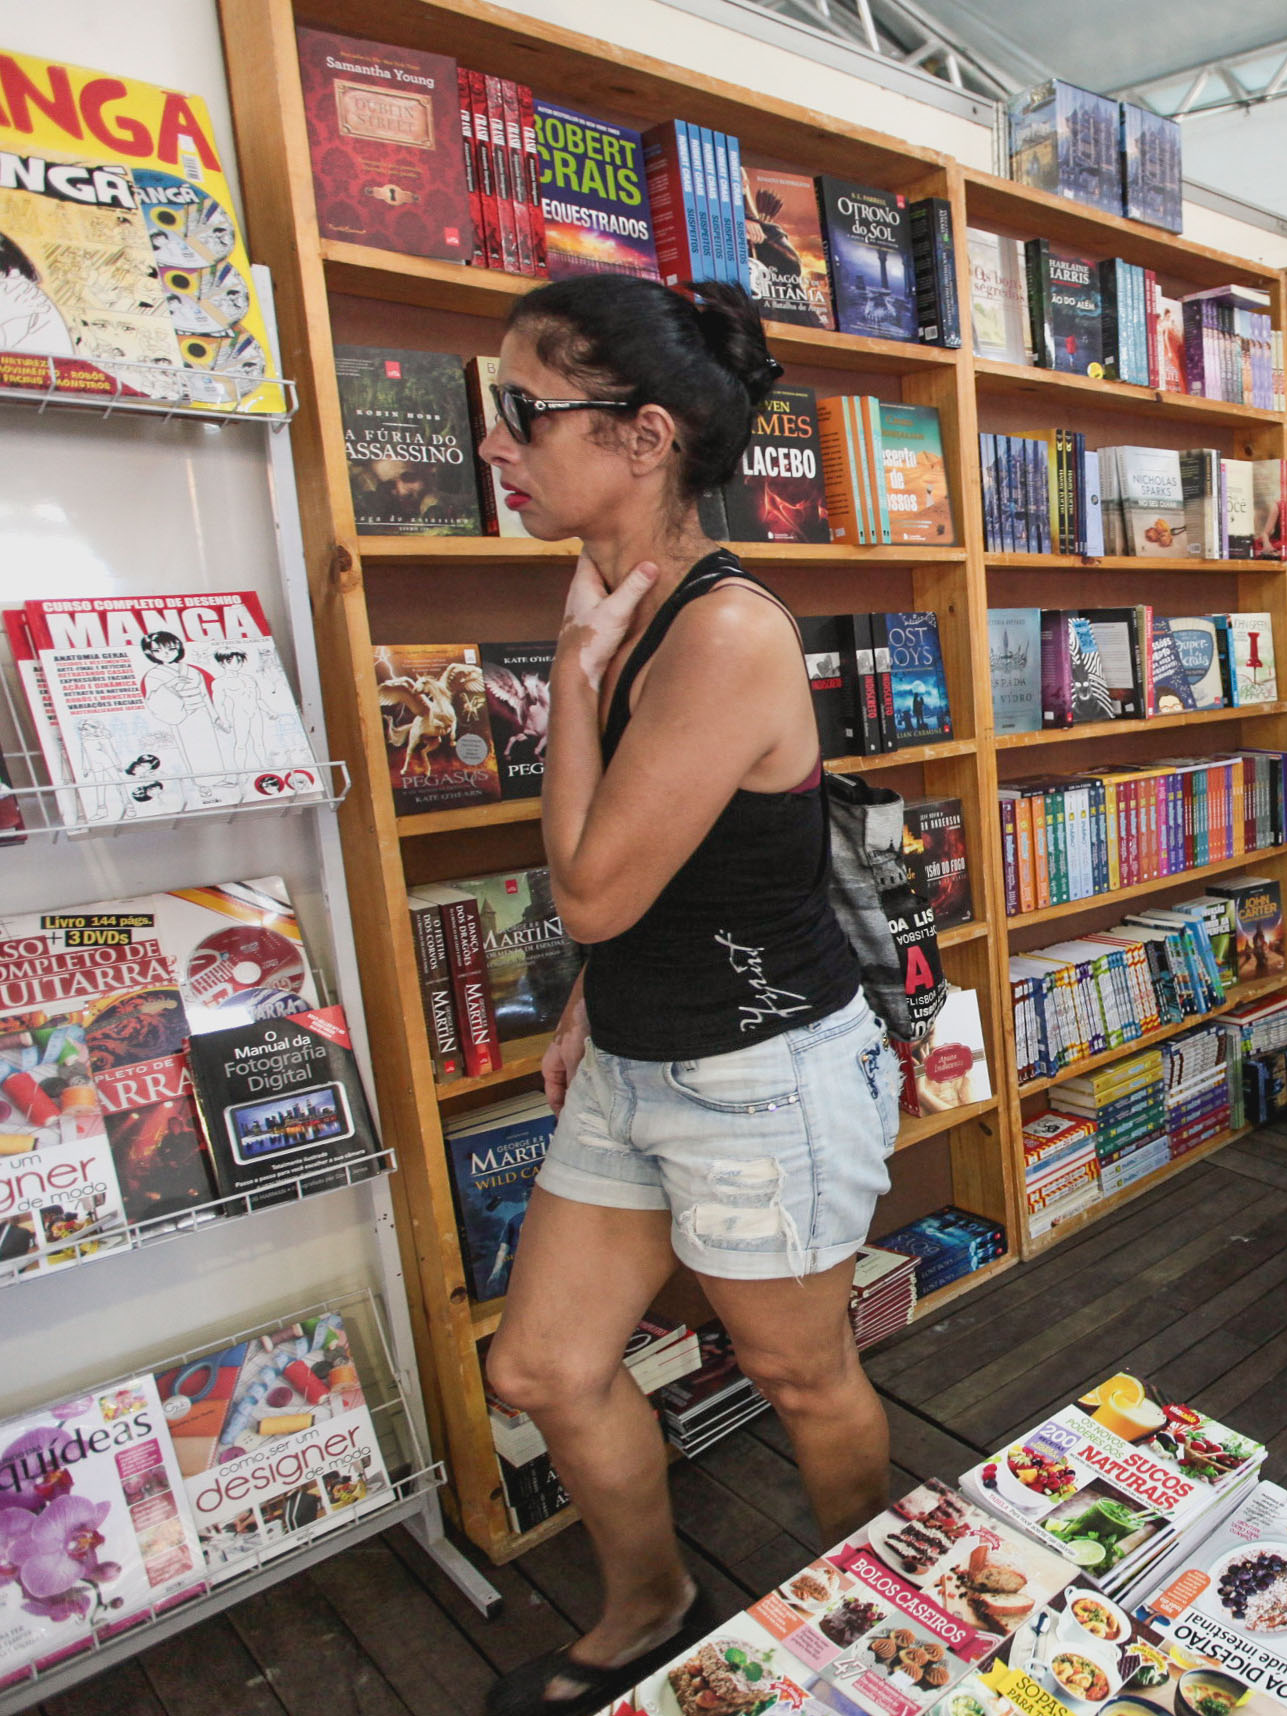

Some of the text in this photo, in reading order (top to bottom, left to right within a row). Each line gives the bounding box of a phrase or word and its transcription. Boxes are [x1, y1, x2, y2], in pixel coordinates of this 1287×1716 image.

[326, 56, 435, 88] Samantha Young
[0, 53, 221, 172] NGÁ
[541, 197, 649, 241] EQUESTRADOS
[687, 208, 698, 254] SUSPEITOS
[699, 211, 711, 257] SUSPEITOS
[852, 219, 896, 244] do SOL
[712, 214, 723, 260] SUSPEITOS
[724, 217, 735, 263] SUSPEITOS
[736, 221, 747, 265] SUSPEITOS
[1049, 259, 1089, 274] HARLAINE
[365, 428, 457, 446] FÚRIA DO
[751, 415, 813, 439] MES
[344, 442, 464, 465] ASSASSINO
[742, 445, 816, 479] LACEBO
[890, 468, 905, 489] de
[1132, 474, 1177, 487] NICHOLAS
[1141, 485, 1172, 497] SPARKS
[42, 595, 242, 612] CURSO COMPLETO DE DESENHO
[503, 655, 556, 664] KATE O'HEA
[402, 769, 489, 790] PEGASUS
[951, 857, 965, 873] FOGO
[1238, 903, 1278, 920] CARTER
[1246, 894, 1270, 910] JOHN
[45, 916, 152, 929] Livro 144 págs.
[68, 931, 129, 945] 3 DVDs
[456, 905, 472, 967] DOS DRAGÕES
[467, 922, 479, 954] DANÇA
[124, 940, 160, 957] DE
[423, 914, 438, 970] DOS CORVOS
[434, 928, 446, 960] FESTIM
[432, 990, 457, 1054] MARTIN
[466, 983, 490, 1045] MARTIN
[234, 1034, 311, 1060] Manual da
[265, 1030, 277, 1042] O
[153, 1059, 174, 1070] DE
[224, 1044, 327, 1079] Fotografia
[247, 1063, 313, 1093] Digital
[10, 1154, 42, 1169] um
[471, 1142, 546, 1175] MARTI
[497, 1139, 529, 1153] GEORGE
[475, 1170, 517, 1191] WILD
[17, 1181, 107, 1213] de moda
[1040, 1423, 1078, 1448] 200
[1066, 1418, 1124, 1460] PODERES DOS
[1081, 1416, 1126, 1449] OS NOVOS
[196, 1424, 361, 1513] designer
[219, 1429, 320, 1477] como ser um
[305, 1445, 372, 1482] de moda
[1077, 1445, 1180, 1511] NATURAIS
[1122, 1452, 1195, 1498] SUCOS
[850, 1557, 967, 1645] BOLOS CASEIROS
[1184, 1612, 1258, 1661] intestinal
[832, 1658, 868, 1681] 47
[1174, 1625, 1266, 1684] DIGESTÃO
[1007, 1689, 1037, 1715] PARA
[1015, 1676, 1069, 1716] SOPAS
